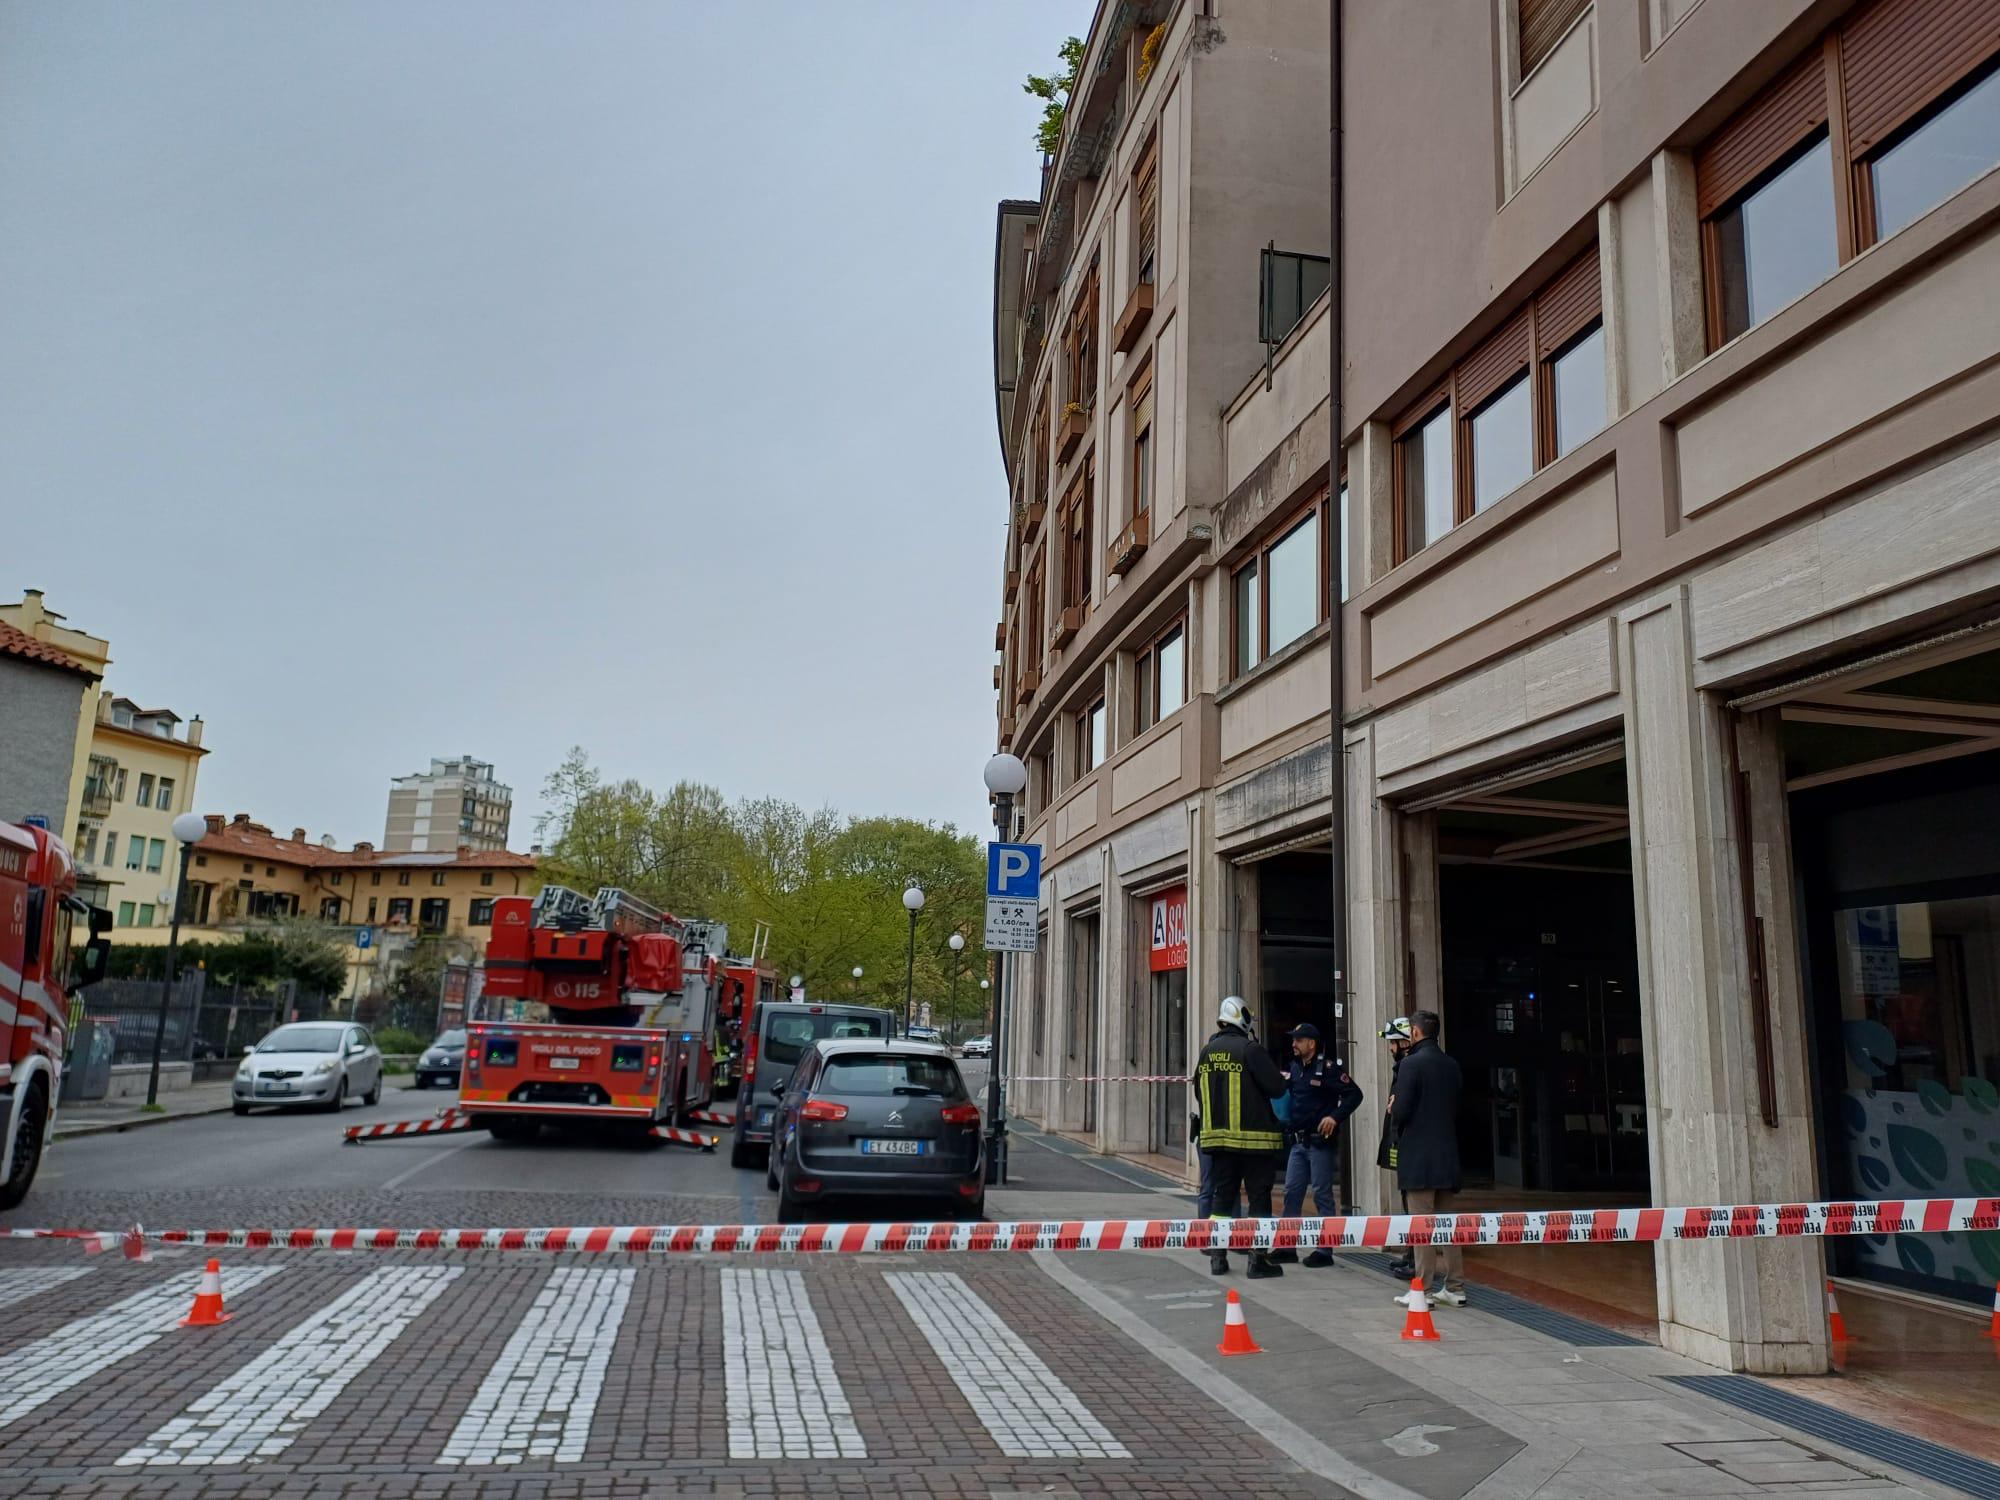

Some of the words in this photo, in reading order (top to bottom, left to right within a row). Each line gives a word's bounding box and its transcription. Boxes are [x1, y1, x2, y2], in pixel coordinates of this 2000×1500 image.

[998, 848, 1030, 891] P
[359, 931, 369, 946] P
[575, 983, 600, 998] 115
[1209, 1052, 1231, 1062] VIGILI
[1199, 1063, 1212, 1073] DEL
[1213, 1062, 1243, 1073] FUOCO
[1699, 1210, 1728, 1222] CROSS
[1751, 1208, 1765, 1220] DO
[1774, 1207, 1810, 1219] DANGER
[1820, 1204, 1882, 1218] FIREFIGHTERS
[1425, 1217, 1453, 1229] CROSS
[1496, 1215, 1530, 1227] DANGER
[1539, 1214, 1597, 1226] FIREFIGHTERS
[1865, 1219, 1883, 1231] DEL
[1885, 1218, 1915, 1231] VIGILI
[1270, 1221, 1325, 1232] FIREFIGHTERS
[1749, 1225, 1766, 1237] NON
[1776, 1222, 1822, 1236] PERICOLO
[1832, 1220, 1863, 1233] FUOCO
[1328, 1233, 1355, 1245] VIGILI
[1399, 1232, 1468, 1244] OLTREPASSARE
[1470, 1231, 1487, 1242] NON
[1497, 1230, 1540, 1242] PERICOLO
[1549, 1229, 1578, 1241] FUOCO
[1580, 1228, 1597, 1240] DEL
[1600, 1227, 1629, 1239] VIGILI
[1673, 1226, 1748, 1240] OLTREPASSARE
[1133, 1236, 1200, 1248] OLTREPASSARE
[1228, 1235, 1270, 1246] PERICOLO
[1280, 1235, 1307, 1246] FUOCO
[1309, 1234, 1326, 1245] DEL
